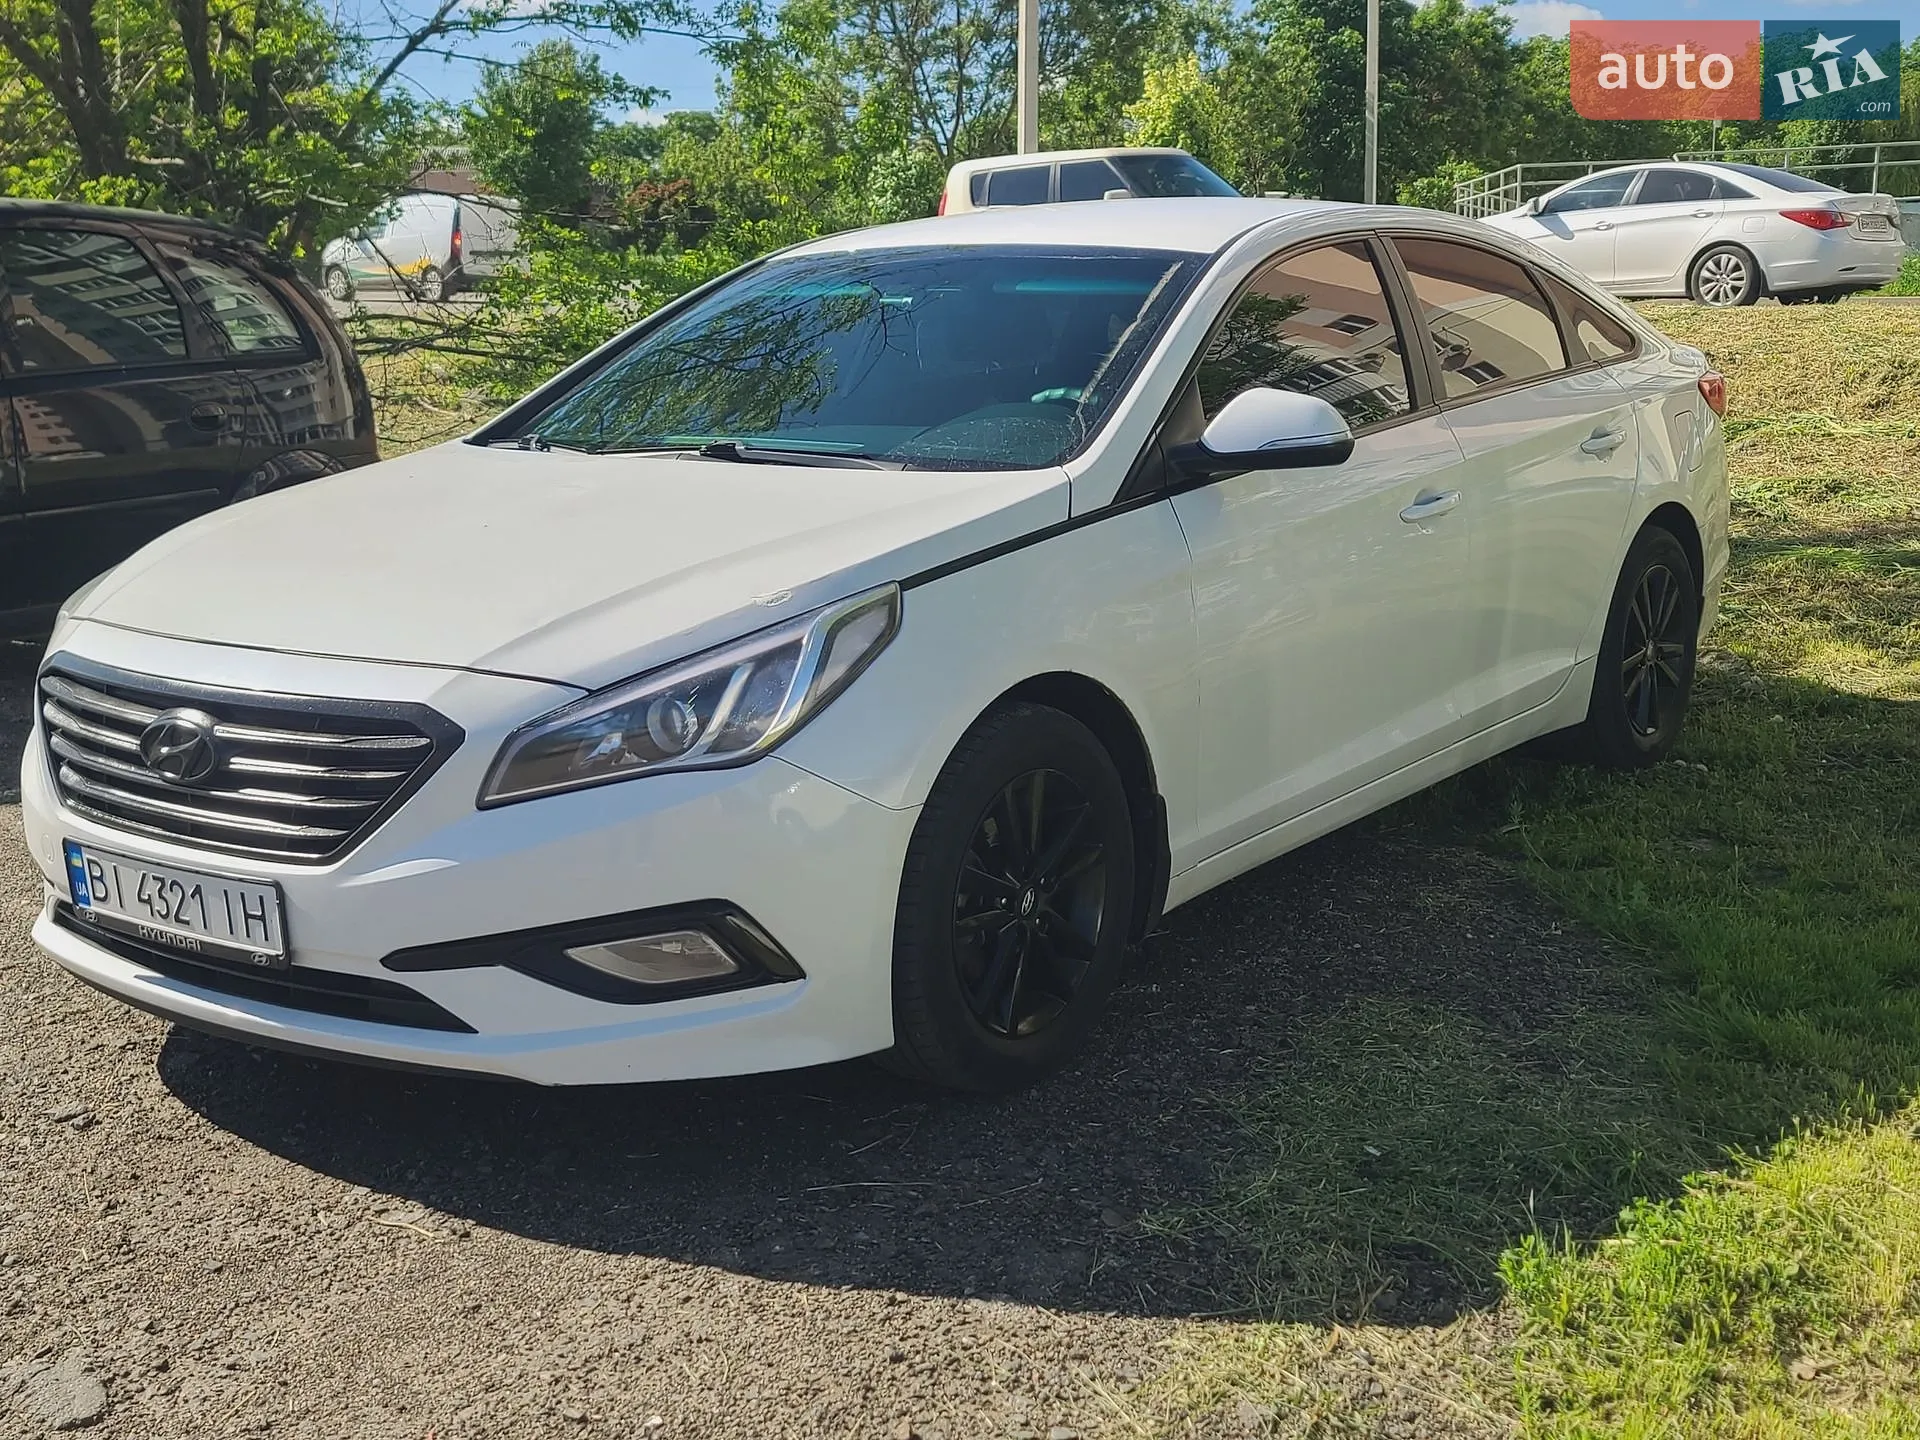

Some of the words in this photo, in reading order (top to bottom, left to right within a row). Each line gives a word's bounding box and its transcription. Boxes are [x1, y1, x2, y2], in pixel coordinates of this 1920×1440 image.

[75, 881, 89, 898] UA
[86, 856, 124, 909] BI
[137, 870, 207, 930] 4321
[223, 889, 269, 942] IH
[138, 925, 202, 952] HYUNDAI
